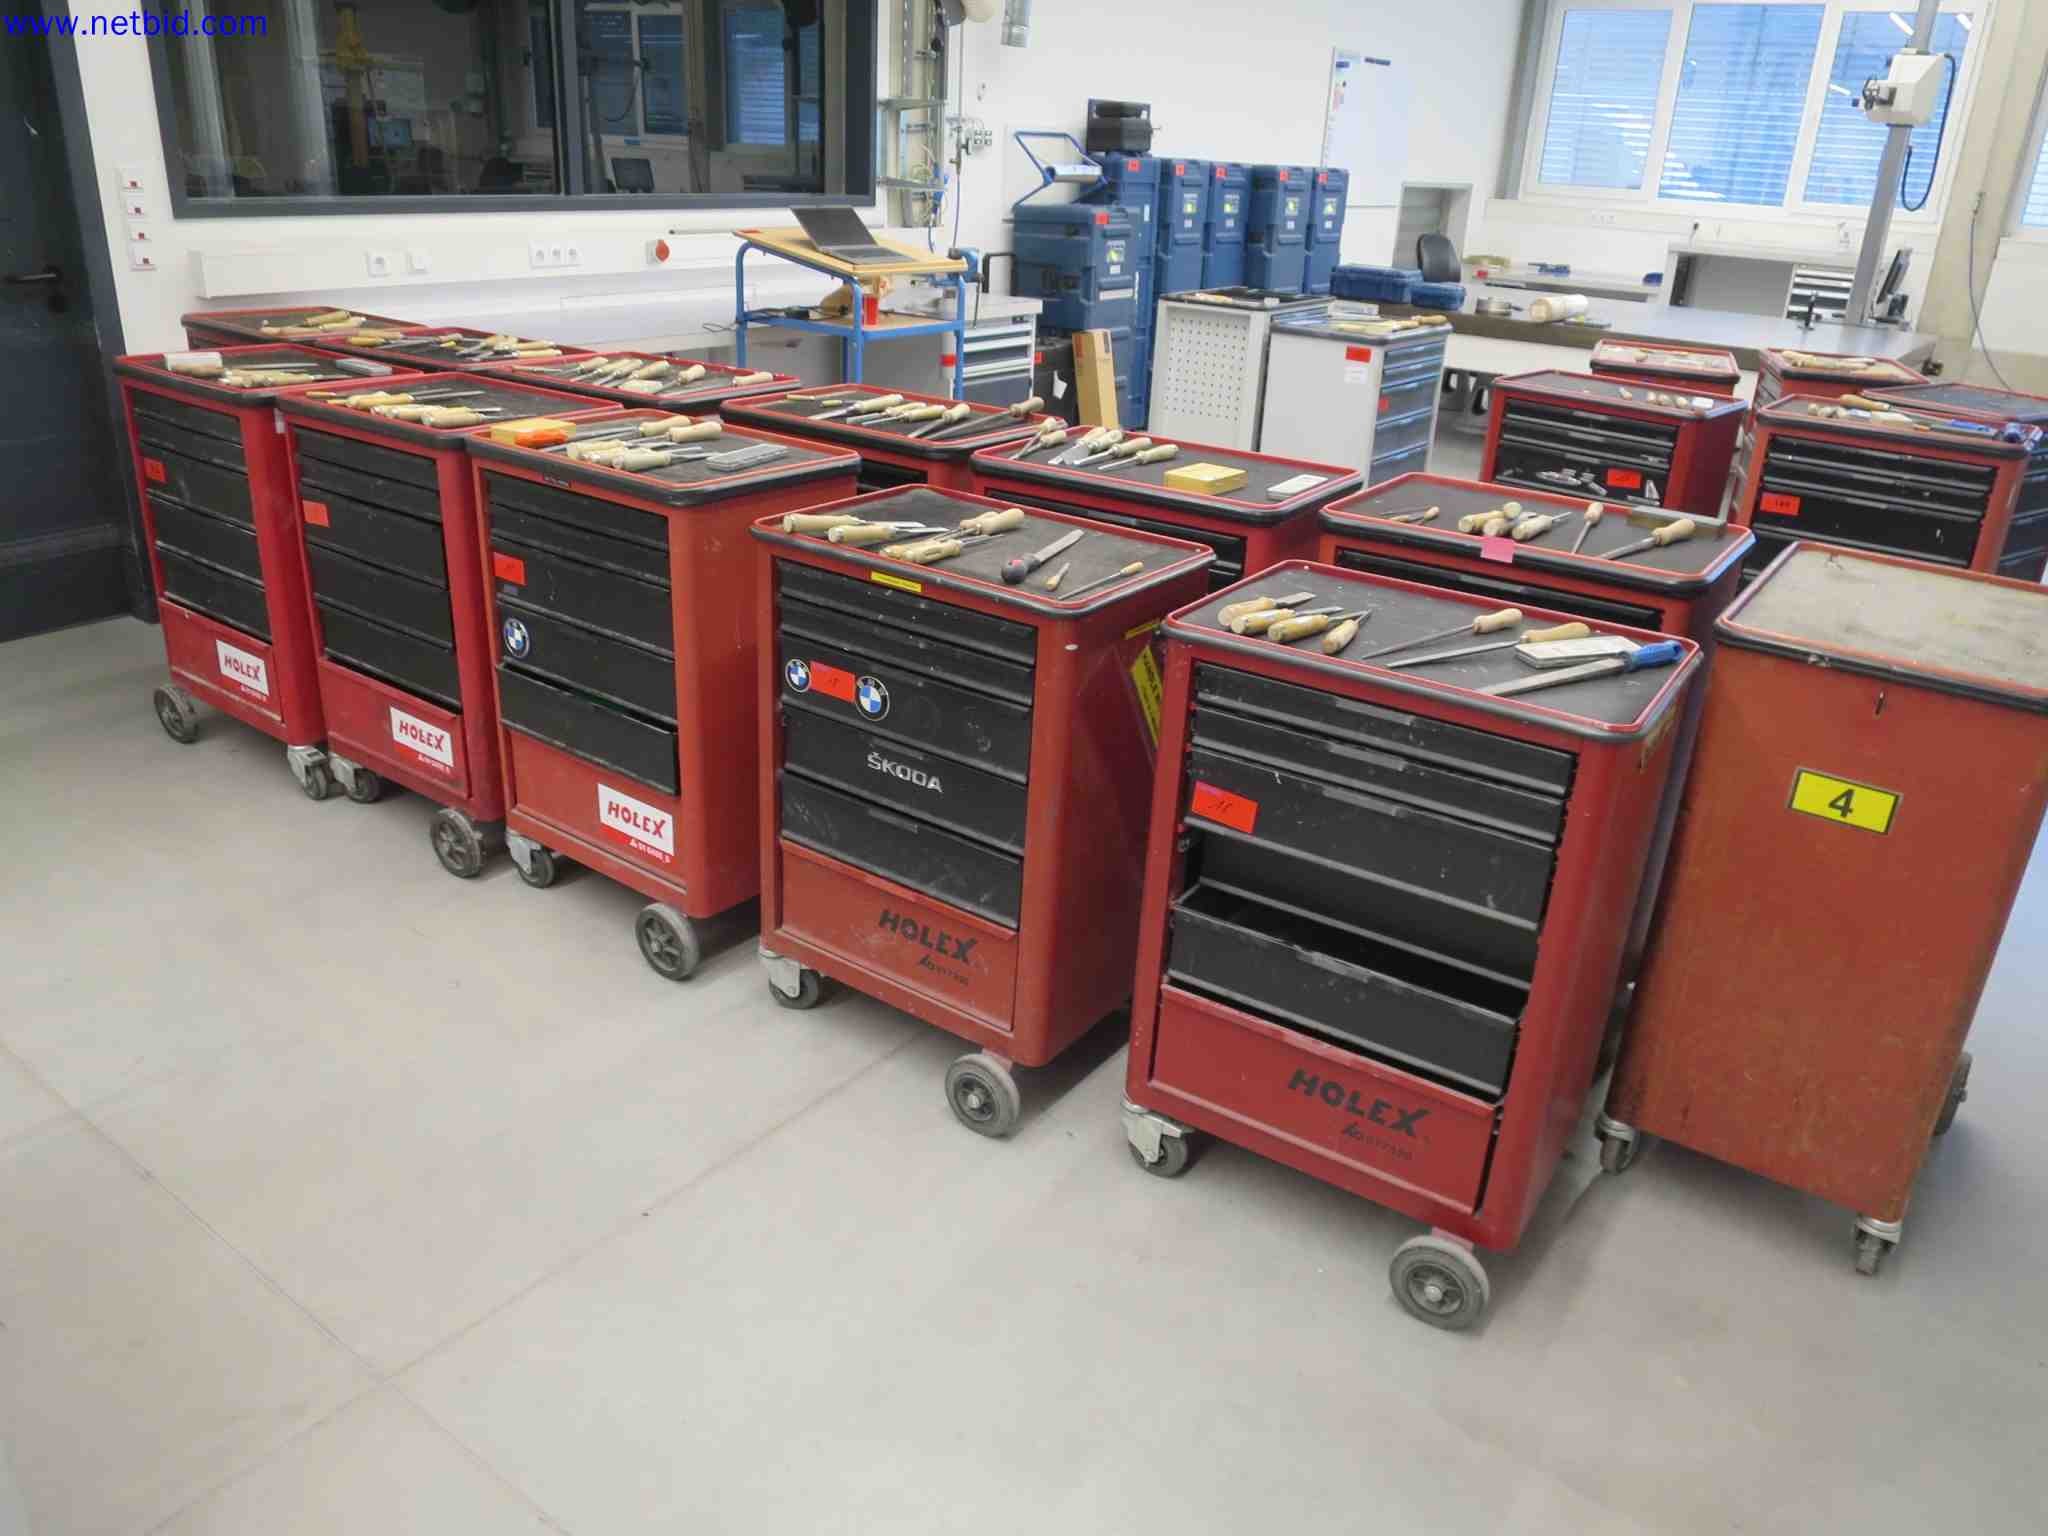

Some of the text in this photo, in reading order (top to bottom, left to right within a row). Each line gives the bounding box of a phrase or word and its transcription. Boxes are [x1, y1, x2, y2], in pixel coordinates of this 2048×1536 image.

[224, 655, 261, 682] HOLEX
[399, 720, 445, 753] HOLEX
[867, 751, 943, 793] ŠKODA
[607, 800, 667, 839] HOLEX
[1827, 788, 1855, 818] 4
[879, 909, 977, 966] HOLEX
[1287, 1066, 1431, 1137] HOLEX
